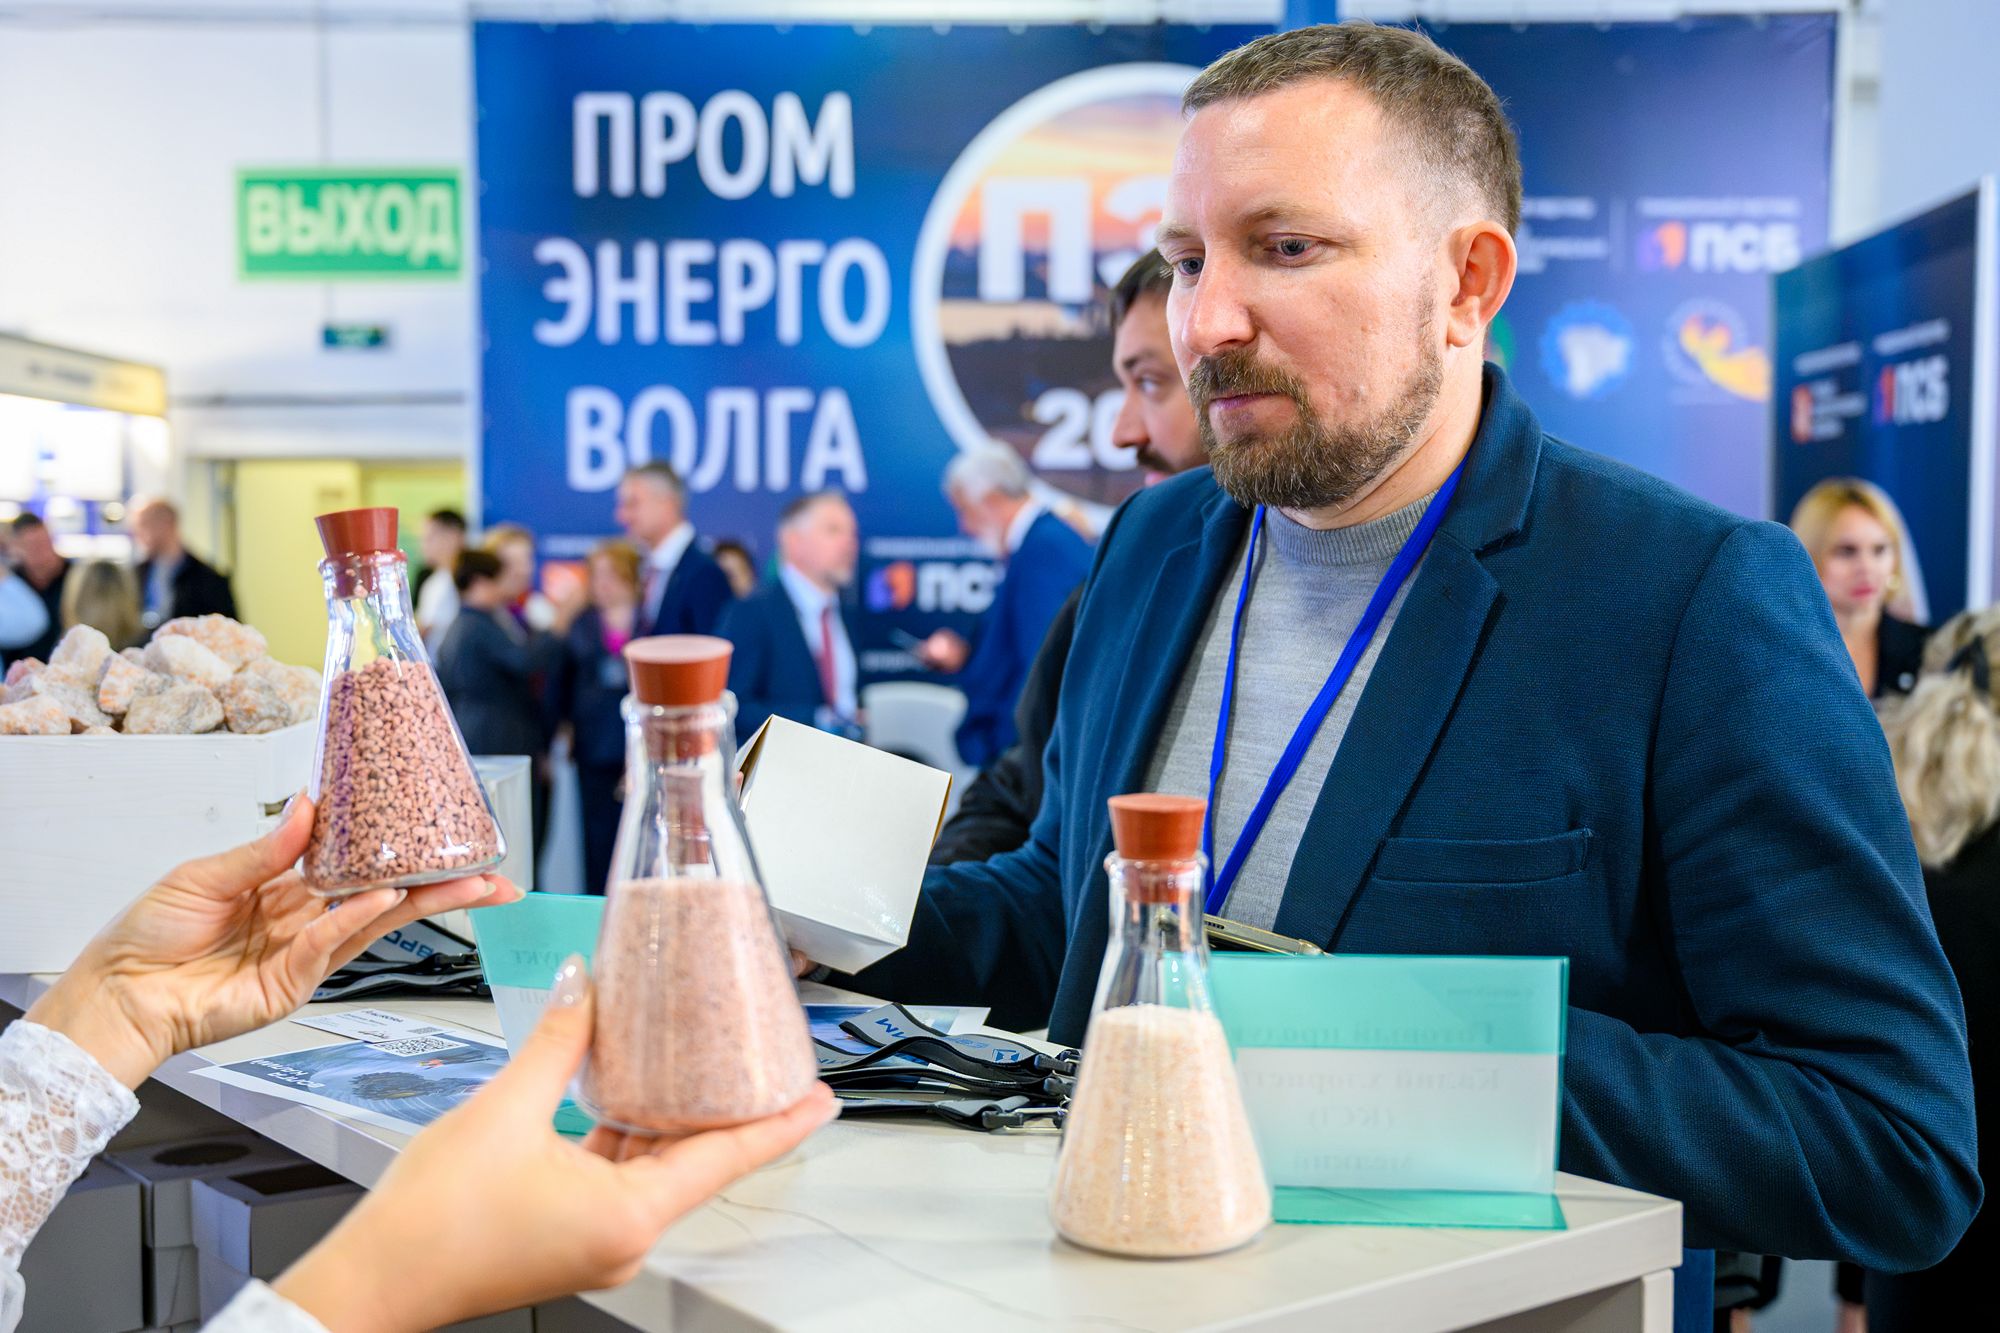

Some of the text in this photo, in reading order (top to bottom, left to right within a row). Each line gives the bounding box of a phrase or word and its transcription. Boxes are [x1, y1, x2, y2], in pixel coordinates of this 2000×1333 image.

[573, 90, 855, 200] ПРОМ
[245, 182, 456, 267] ВЫХОД
[1689, 220, 1802, 274] ПСБ
[533, 237, 892, 349] ЭНЕРГО
[566, 385, 868, 493] ВОЛГА
